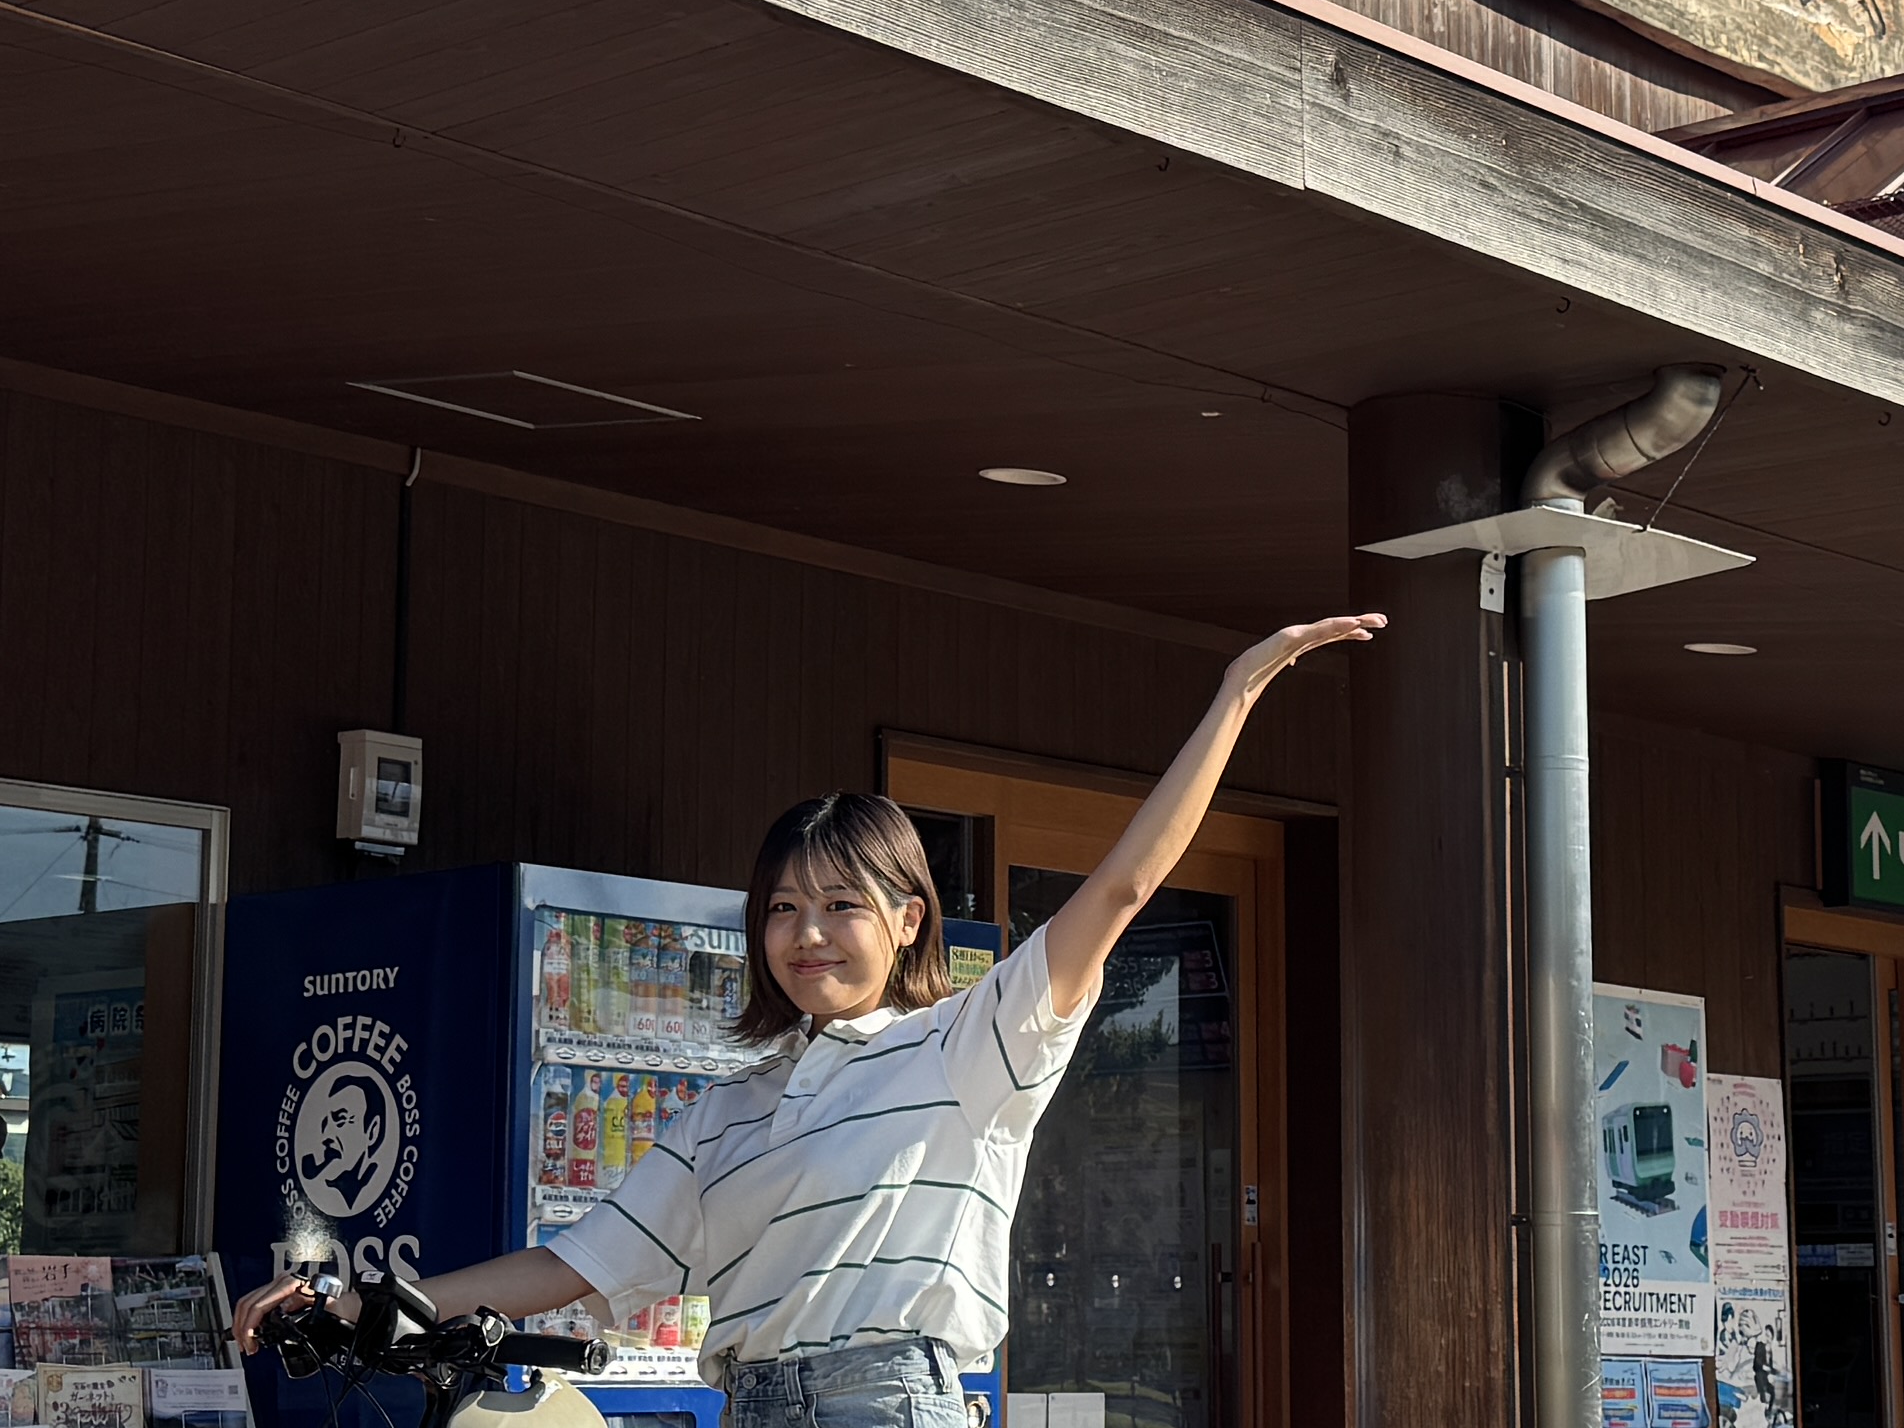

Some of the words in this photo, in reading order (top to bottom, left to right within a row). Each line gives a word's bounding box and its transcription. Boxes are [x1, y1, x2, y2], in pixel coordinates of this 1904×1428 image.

[302, 966, 399, 997] SUNTORY
[292, 1015, 409, 1080] COFFEE
[396, 1072, 420, 1136] BOSS
[274, 1083, 300, 1174] COFFEE
[374, 1138, 419, 1229] COFFEE
[1718, 1210, 1780, 1230] 受動喫煙対策
[1603, 1267, 1640, 1288] 2026
[1614, 1244, 1649, 1266] EAST
